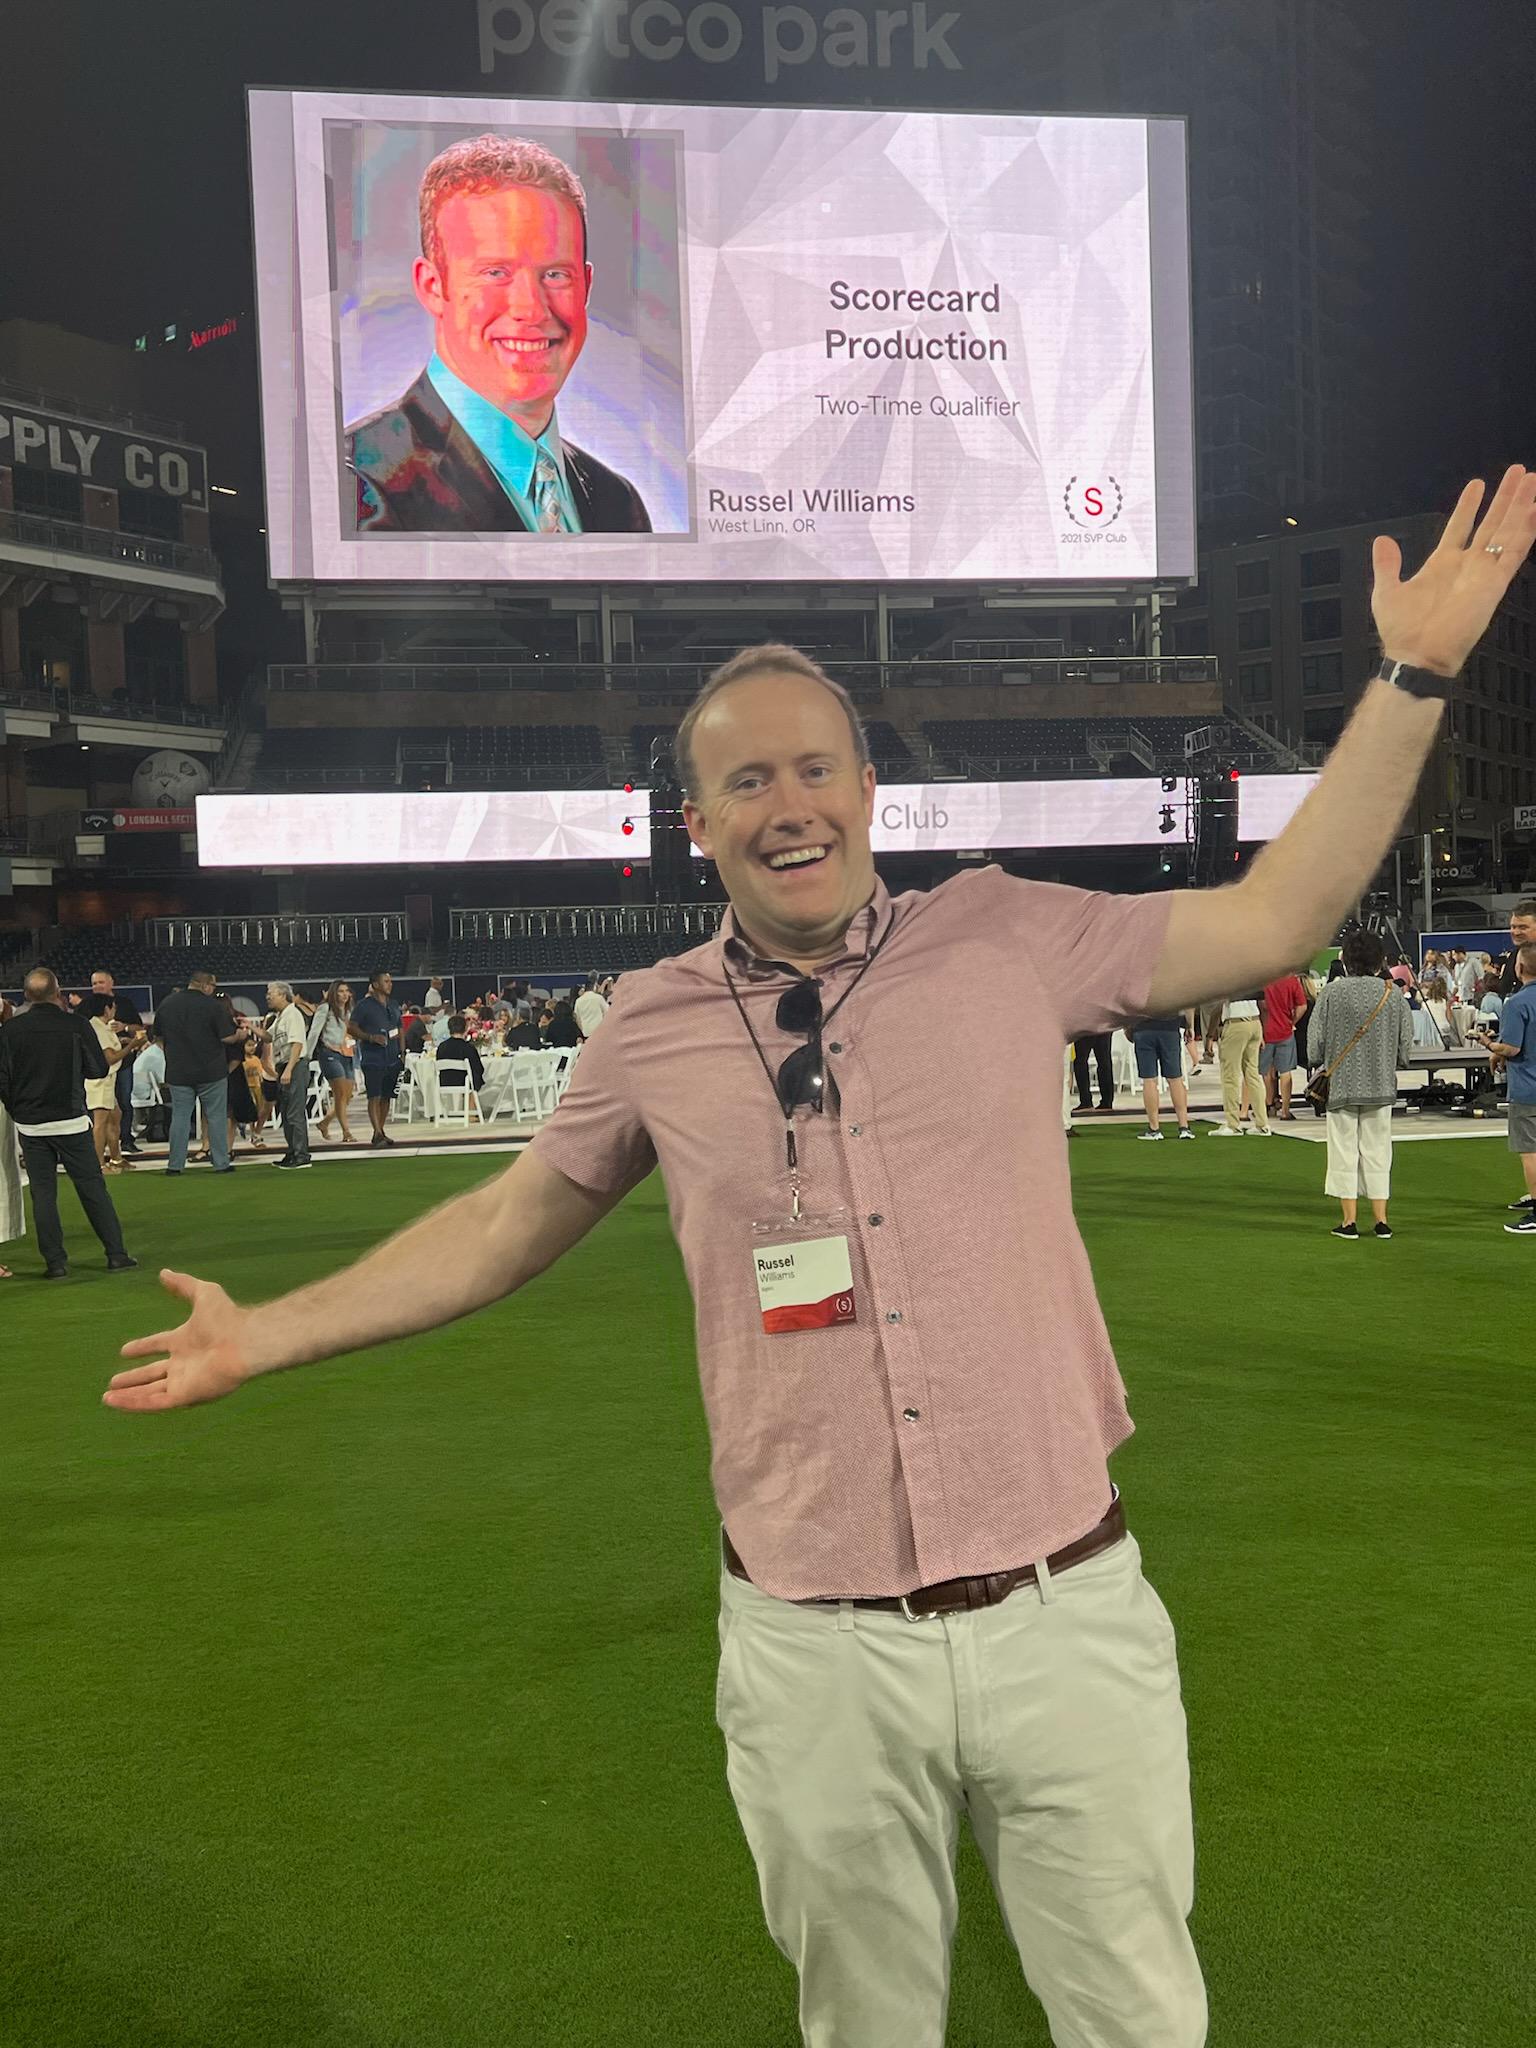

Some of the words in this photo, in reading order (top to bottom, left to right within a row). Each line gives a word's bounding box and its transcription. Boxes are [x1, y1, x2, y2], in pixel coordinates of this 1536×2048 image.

[478, 0, 743, 73] petco
[761, 1, 965, 82] park
[829, 281, 1001, 313] Scorecard
[825, 329, 1007, 362] Production
[815, 394, 923, 417] Two-Time
[929, 394, 1021, 419] Qualifier
[0, 413, 101, 477] PLY
[124, 443, 201, 500] CO.
[709, 489, 794, 513] Russel
[803, 488, 915, 513] Williams
[1084, 487, 1104, 517] S
[709, 518, 749, 534] West
[753, 518, 790, 535] Linn,
[792, 518, 816, 533] OR
[1060, 533, 1083, 544] 2021
[1084, 533, 1103, 543] SVP
[1105, 533, 1127, 544] Club
[881, 803, 949, 830] Club
[757, 1255, 794, 1272] Russel
[759, 1271, 795, 1283] Williams
